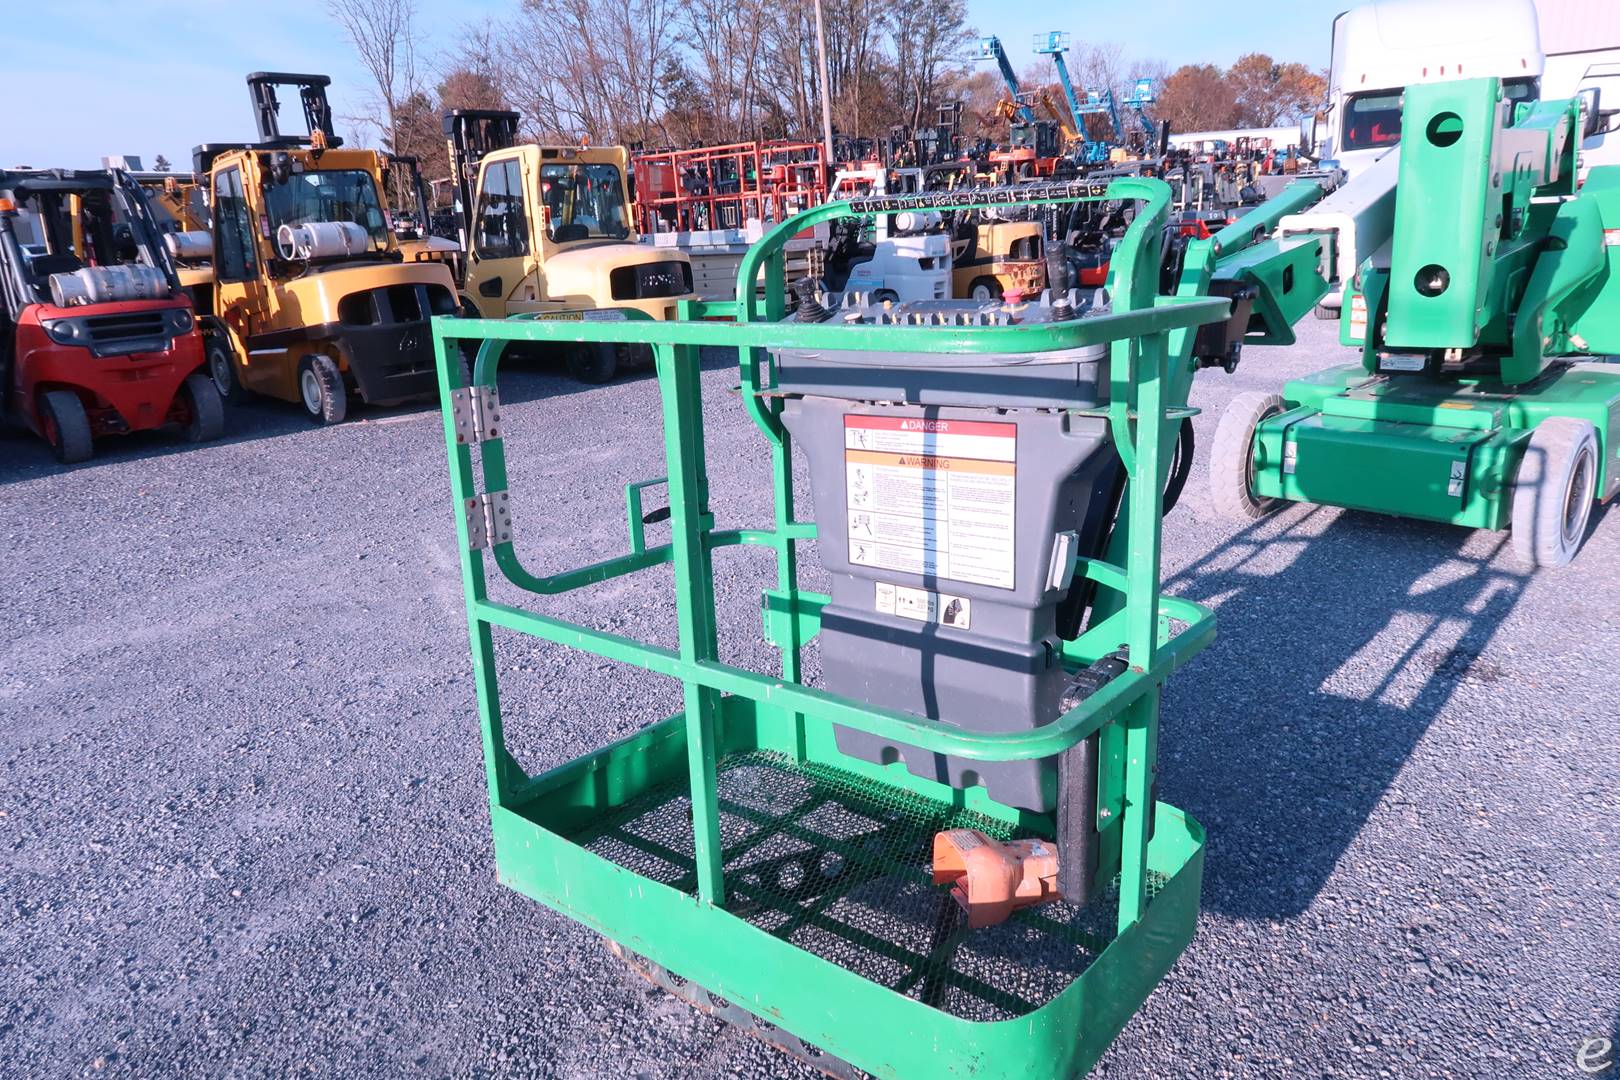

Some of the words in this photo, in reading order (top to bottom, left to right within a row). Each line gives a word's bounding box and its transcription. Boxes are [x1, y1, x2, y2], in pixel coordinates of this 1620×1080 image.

[447, 139, 458, 187] HYSTER
[909, 420, 948, 432] DANGER
[906, 456, 950, 469] WARNING
